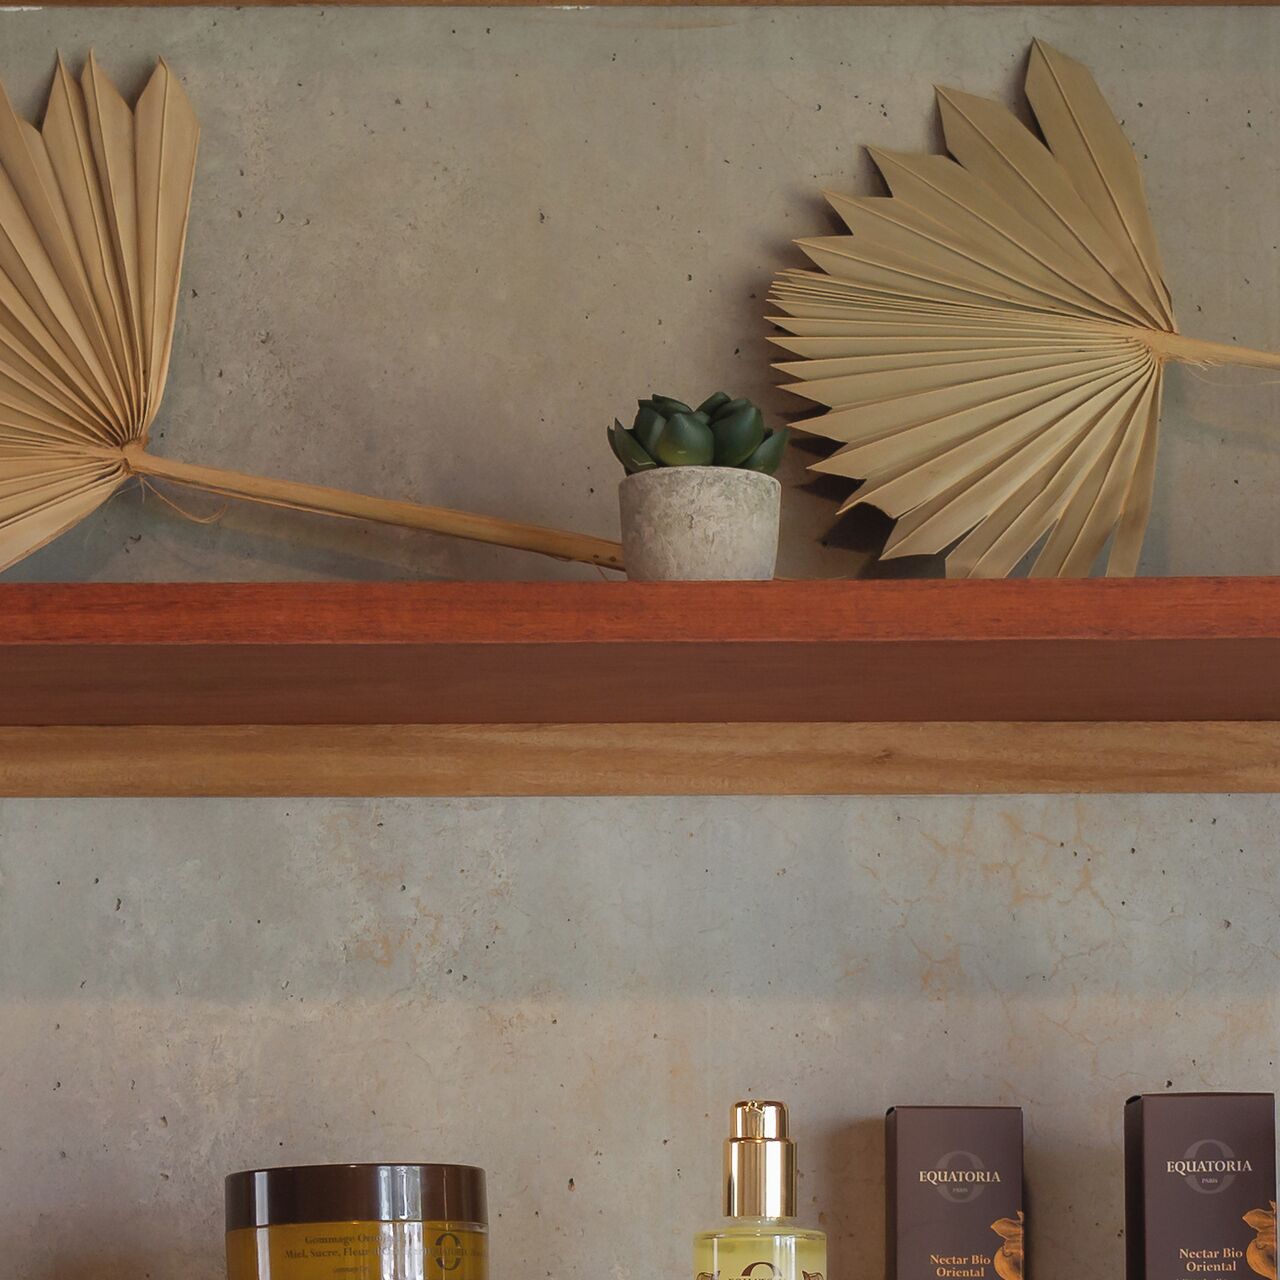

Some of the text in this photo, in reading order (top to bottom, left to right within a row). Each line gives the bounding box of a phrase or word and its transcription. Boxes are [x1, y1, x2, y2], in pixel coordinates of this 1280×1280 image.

[1167, 1160, 1252, 1176] EQUATORIA
[920, 1171, 1000, 1185] EQUATORIA
[1180, 1248, 1242, 1259] Nectar Bio
[930, 1255, 991, 1265] Nectar Bio
[937, 1267, 984, 1277] Oriental
[1186, 1261, 1236, 1272] Oriental
